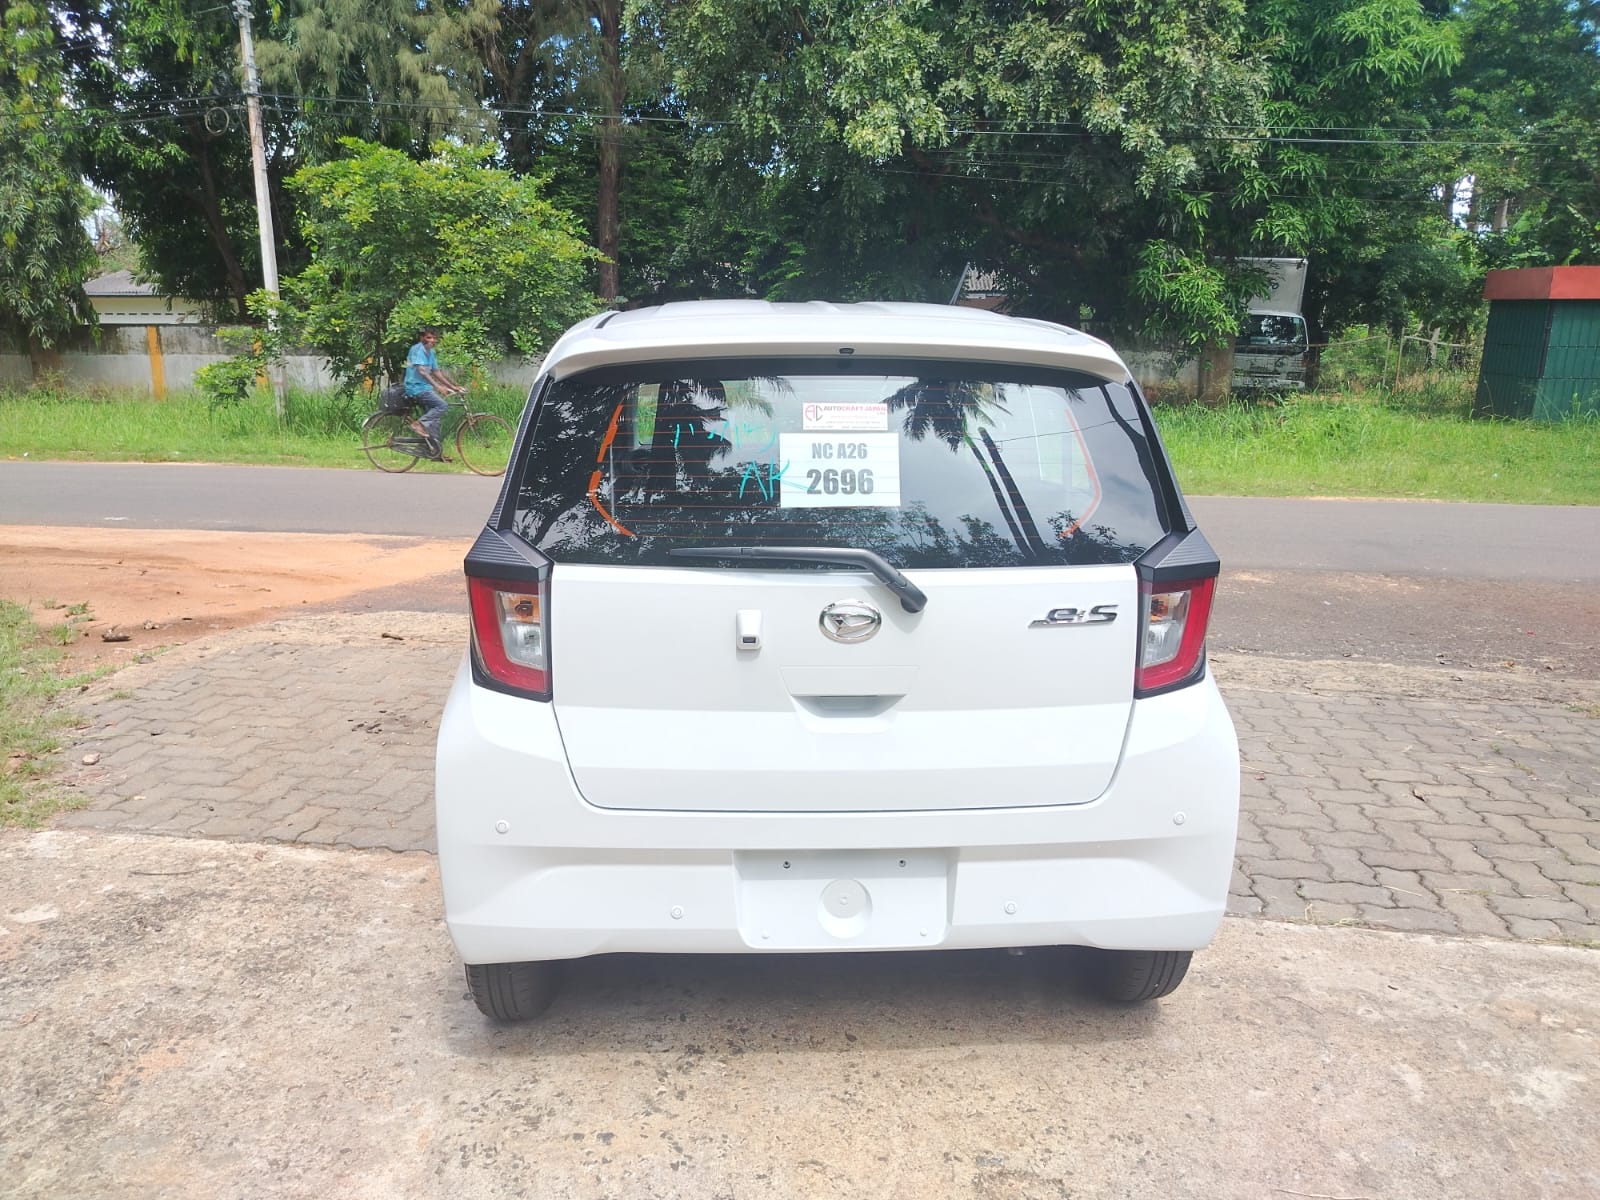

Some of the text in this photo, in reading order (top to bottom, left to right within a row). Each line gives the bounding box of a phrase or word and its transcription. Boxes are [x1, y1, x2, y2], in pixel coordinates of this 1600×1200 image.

[811, 442, 868, 460] NC A26
[806, 468, 874, 495] 2696
